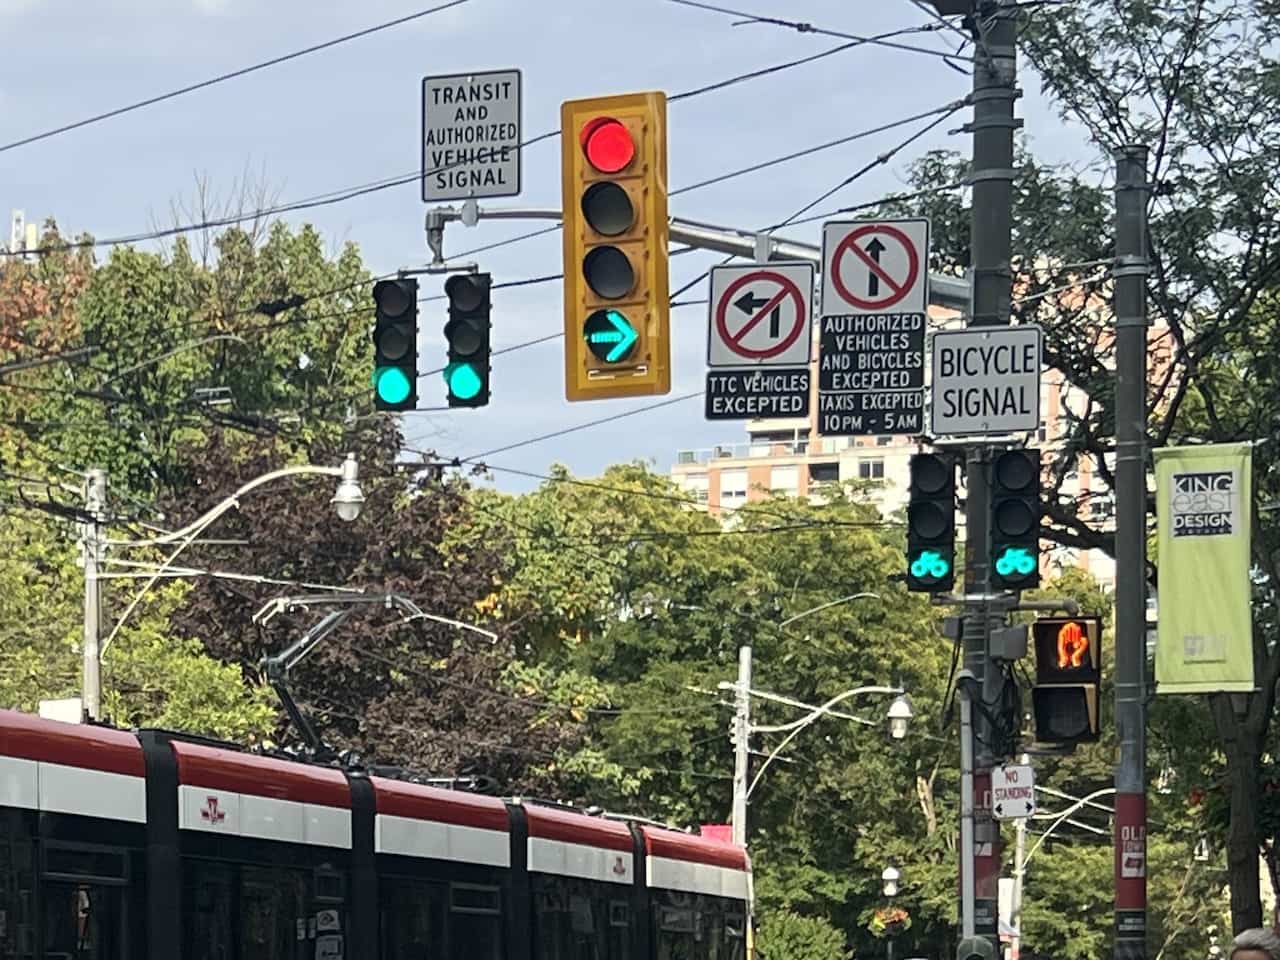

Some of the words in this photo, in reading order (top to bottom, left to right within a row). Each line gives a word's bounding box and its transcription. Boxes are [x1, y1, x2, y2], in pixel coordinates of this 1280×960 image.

[431, 81, 511, 105] TRANSIT
[454, 105, 489, 121] AND
[426, 122, 517, 146] AUTHORIZED
[432, 145, 511, 168] VEHICLE
[436, 167, 507, 189] SIGNAL
[824, 314, 922, 333] AUTHORIZED
[836, 334, 910, 351] VEHICLES
[822, 355, 851, 371] AND
[858, 351, 922, 370] BICYCLES
[939, 344, 1036, 378] BICYCLE
[709, 376, 737, 393] TTC
[743, 373, 809, 393] VEHICLES
[831, 371, 910, 390] EXCEPTED
[712, 395, 803, 414] EXCEPTED
[820, 394, 855, 411] TAXIS
[862, 391, 923, 410] EXCEPTED
[942, 385, 1031, 418] SIGNAL
[1174, 474, 1233, 494] KING
[1172, 490, 1237, 513] east
[1174, 514, 1233, 529] DESIGN
[1004, 771, 1019, 784] NO
[994, 786, 1032, 801] STANDING
